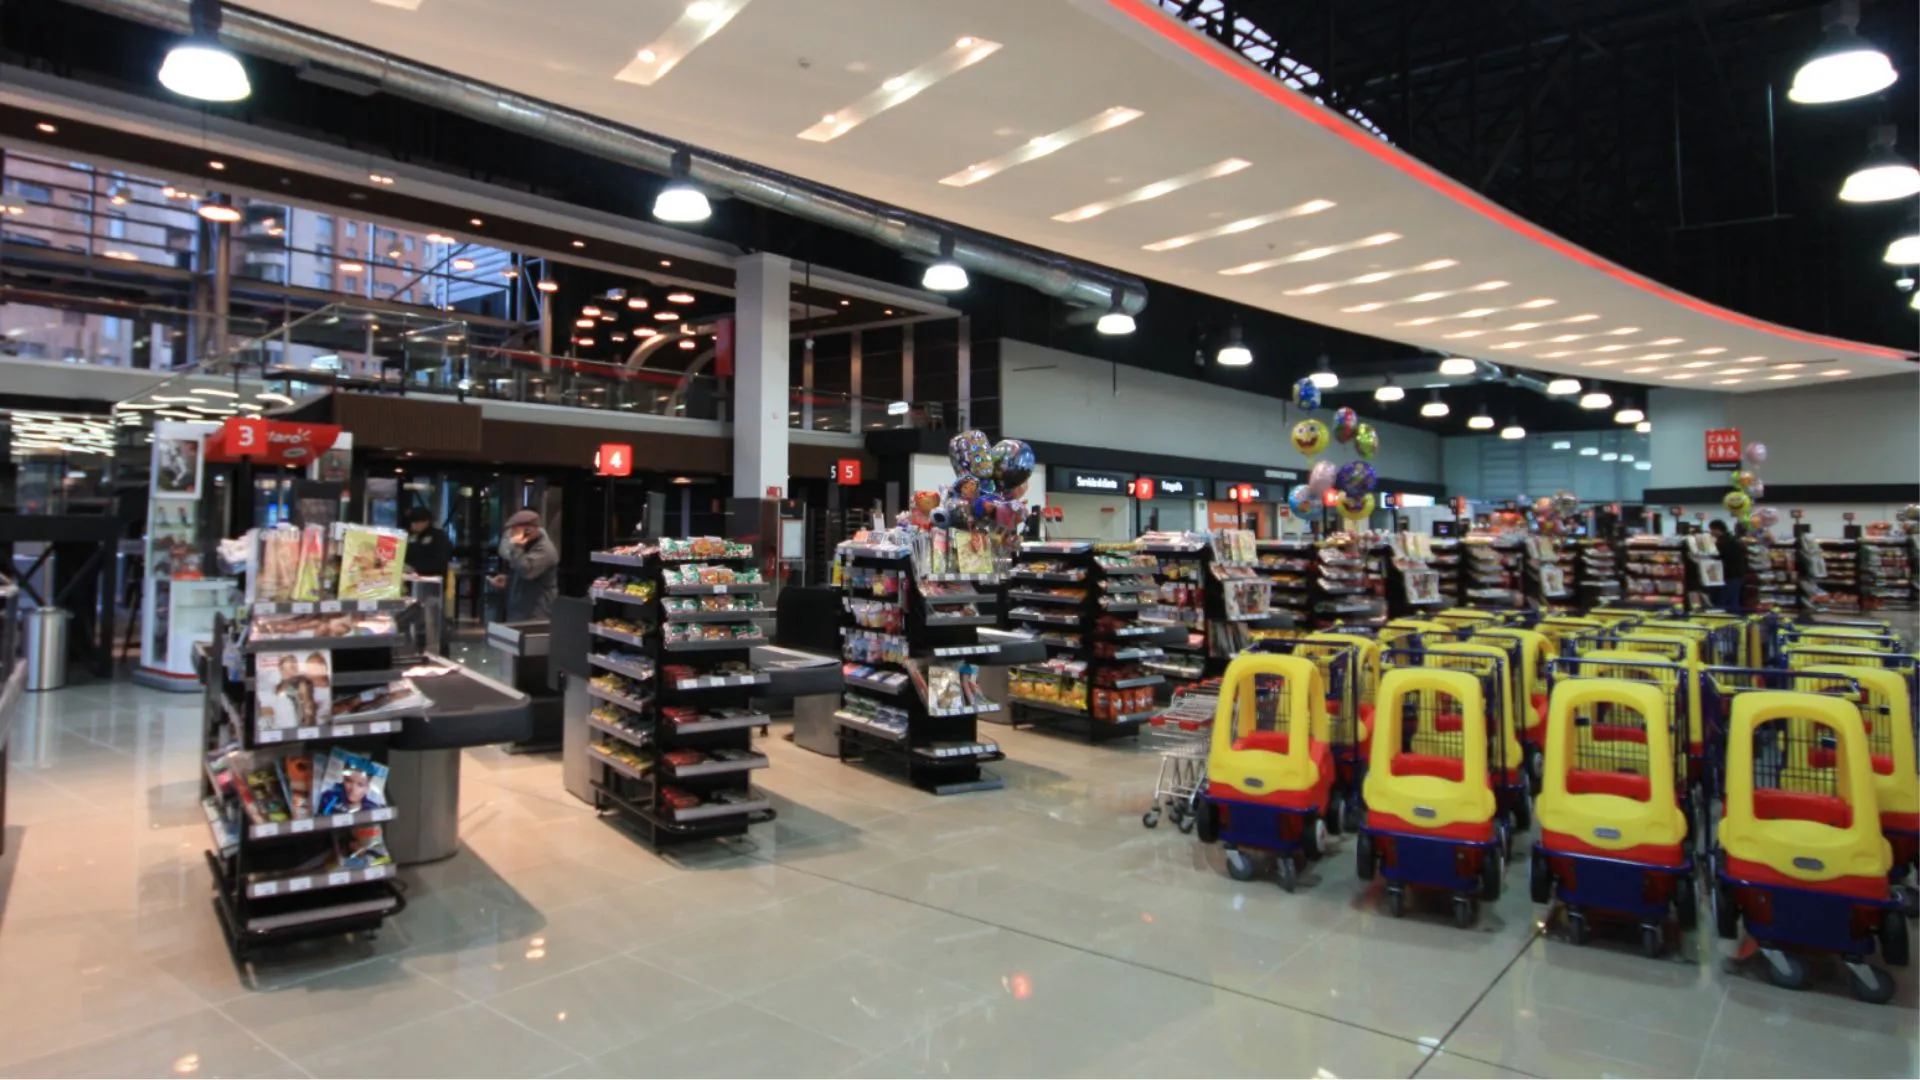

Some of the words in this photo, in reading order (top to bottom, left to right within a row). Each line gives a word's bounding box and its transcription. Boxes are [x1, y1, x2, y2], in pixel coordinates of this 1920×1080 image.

[238, 425, 254, 446] 3
[1708, 434, 1738, 443] CAJA
[610, 451, 622, 468] 4
[830, 465, 836, 479] 5
[845, 465, 853, 478] 5
[1127, 483, 1135, 494] 7
[1141, 483, 1149, 494] 7
